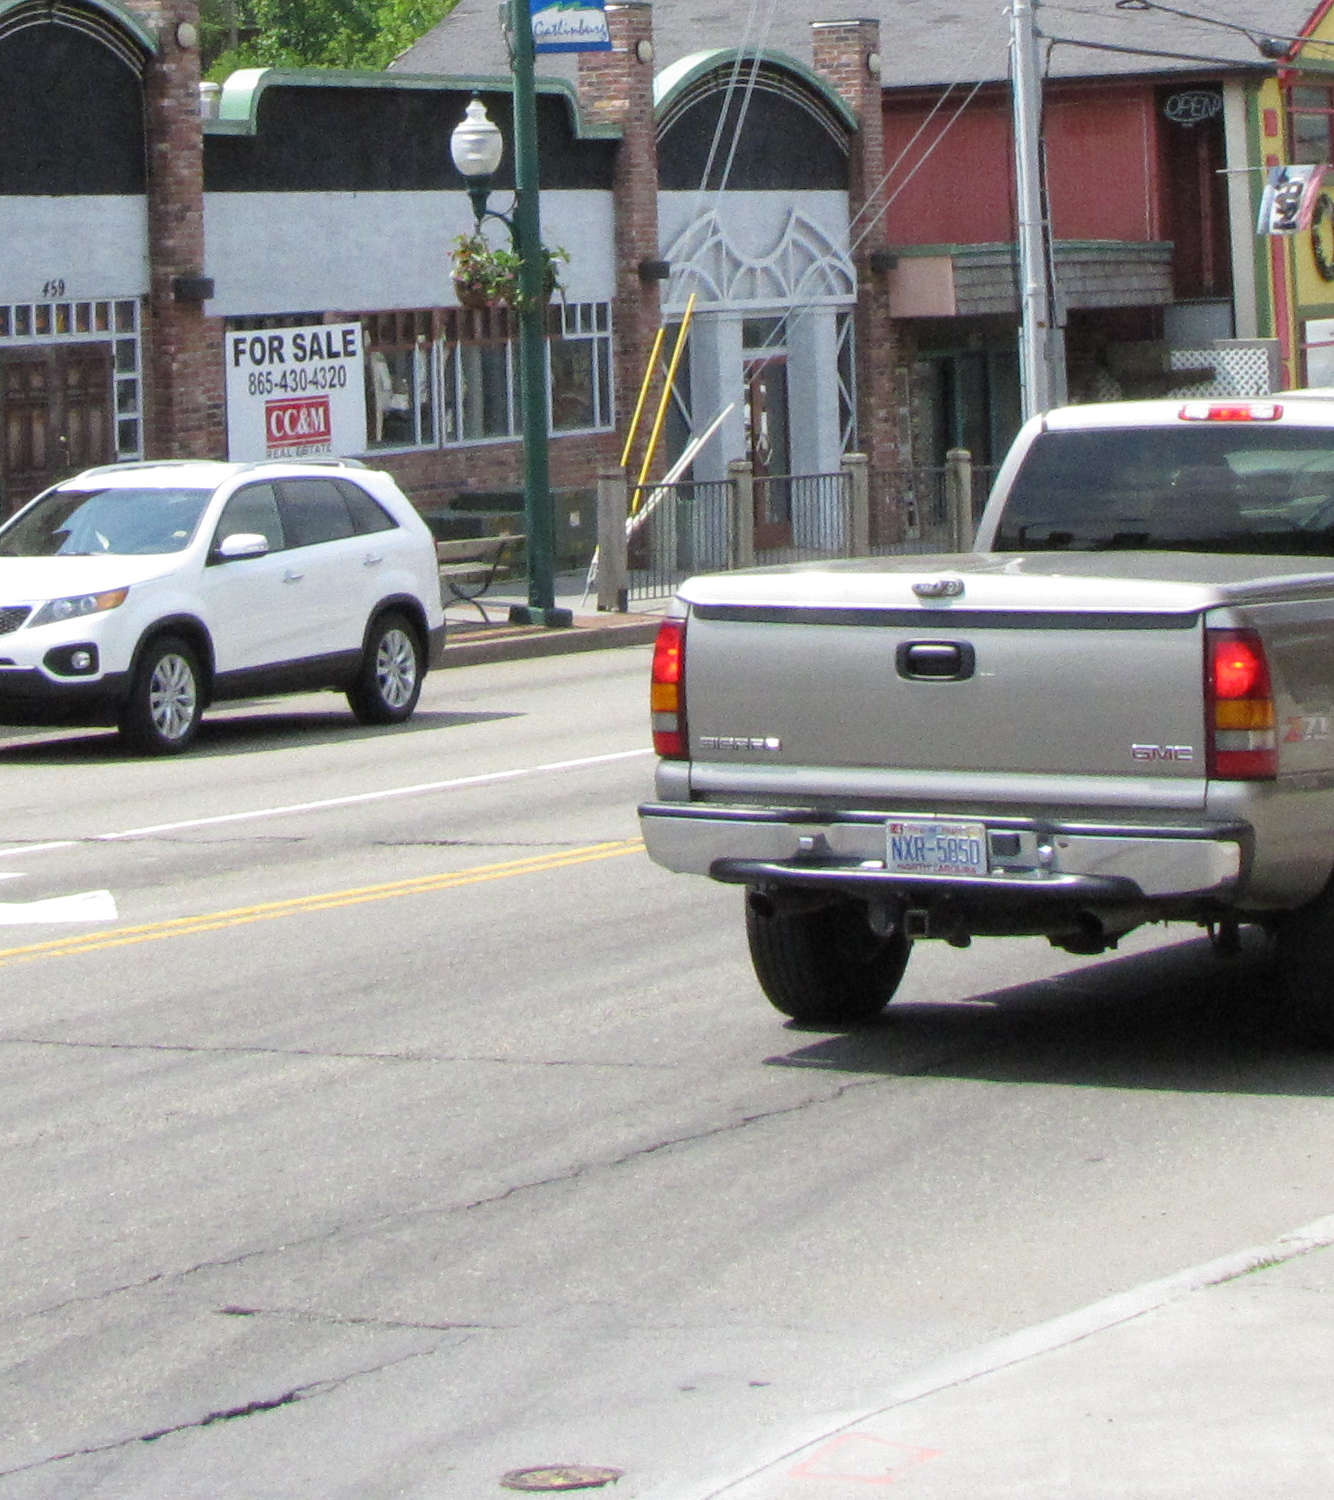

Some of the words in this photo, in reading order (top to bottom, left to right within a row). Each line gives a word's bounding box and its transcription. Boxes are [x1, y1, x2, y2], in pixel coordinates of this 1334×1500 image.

[534, 18, 608, 41] Gatlinburg
[1167, 92, 1222, 118] OPEN
[43, 279, 65, 298] 459
[232, 336, 285, 367] FOR
[292, 329, 357, 362] SALE
[248, 364, 347, 396] 865-430-4320
[270, 406, 327, 437] CC&M
[268, 448, 293, 459] REAL
[1284, 715, 1329, 742] Z71
[1131, 743, 1194, 761] GMC
[891, 835, 980, 865] NXR-5850
